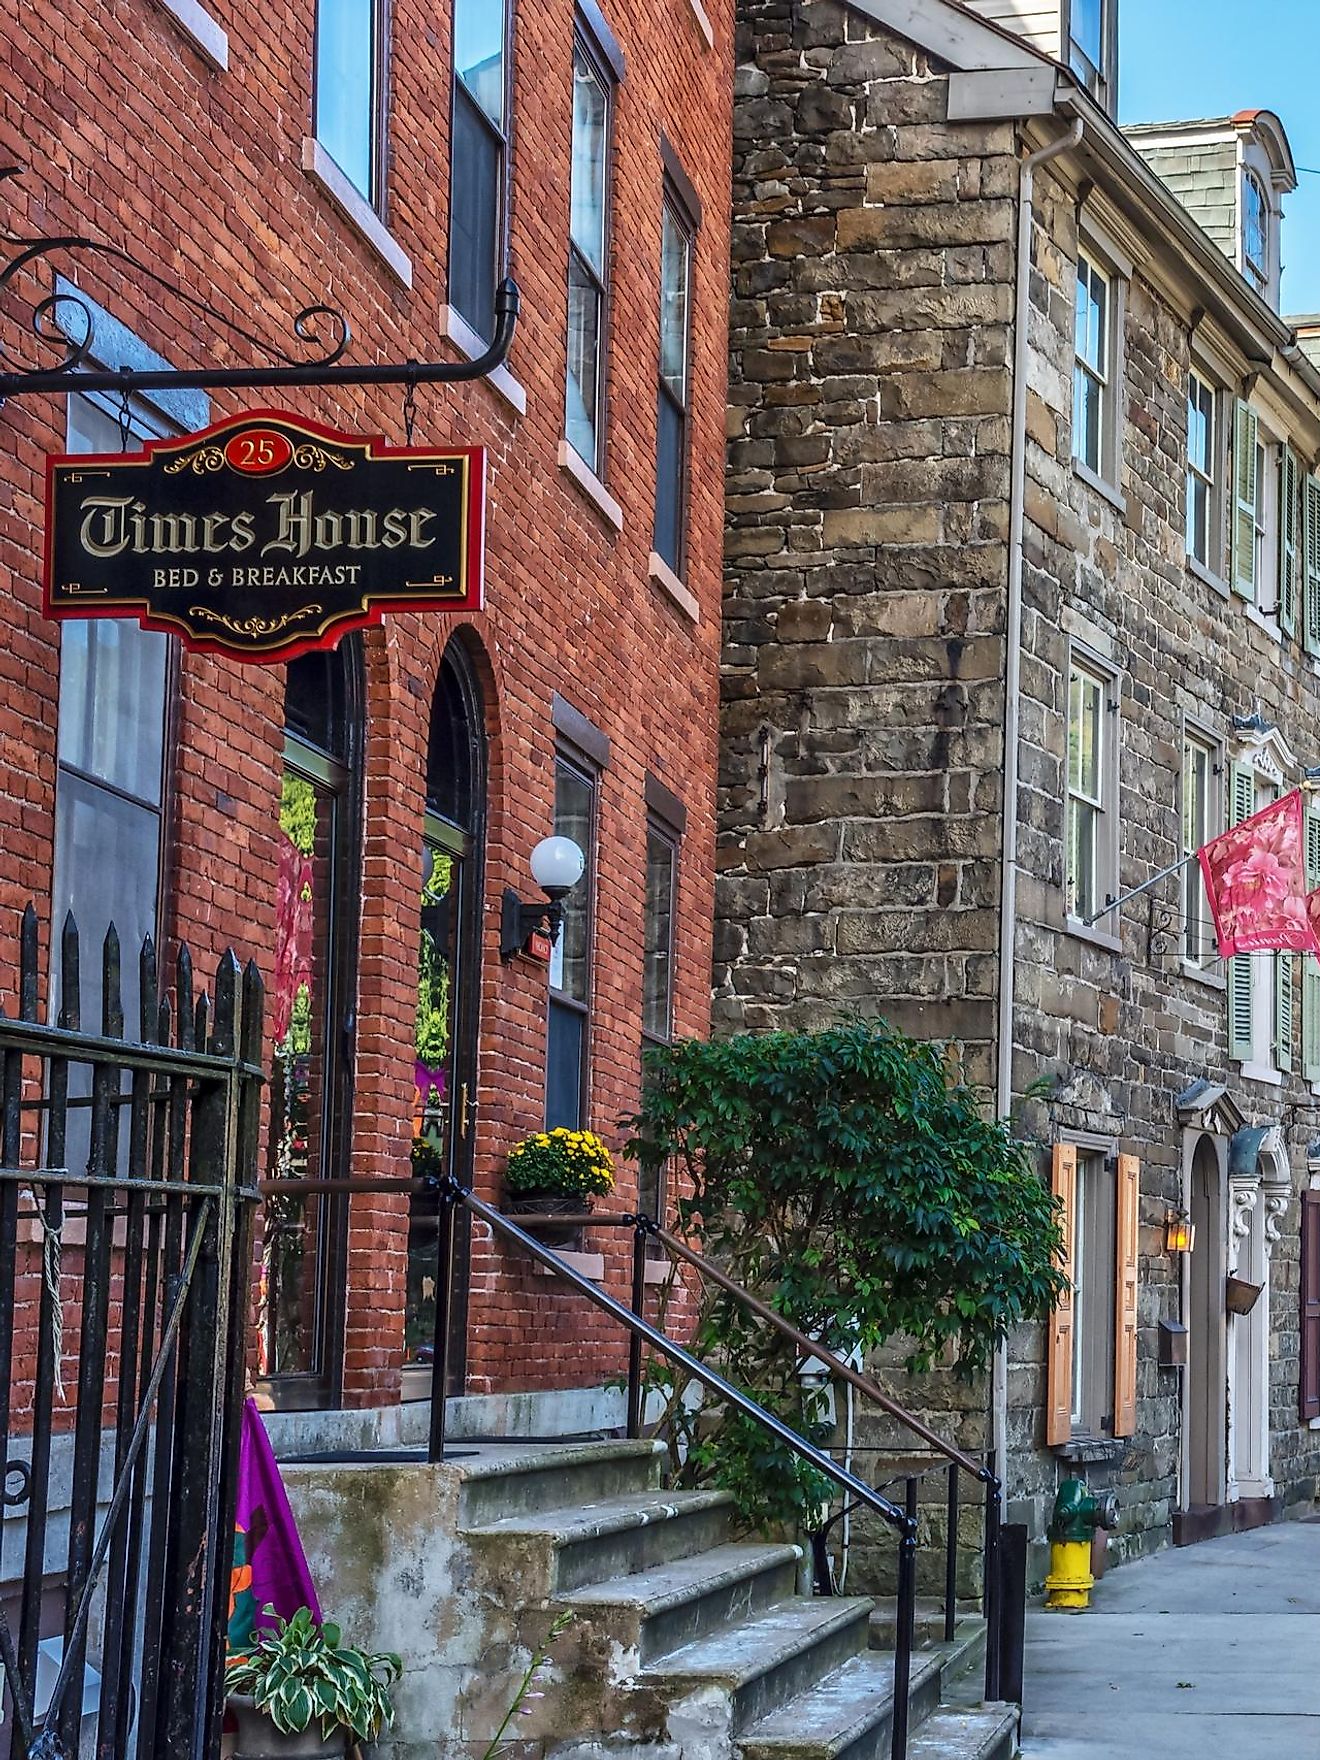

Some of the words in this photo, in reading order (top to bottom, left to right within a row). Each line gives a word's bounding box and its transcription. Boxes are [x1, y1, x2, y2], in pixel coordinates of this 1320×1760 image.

[240, 440, 275, 465] 25
[80, 496, 256, 558] Times
[260, 489, 438, 559] House
[153, 568, 199, 588] BED
[207, 567, 224, 587] &
[232, 565, 361, 587] BREAKFAST
